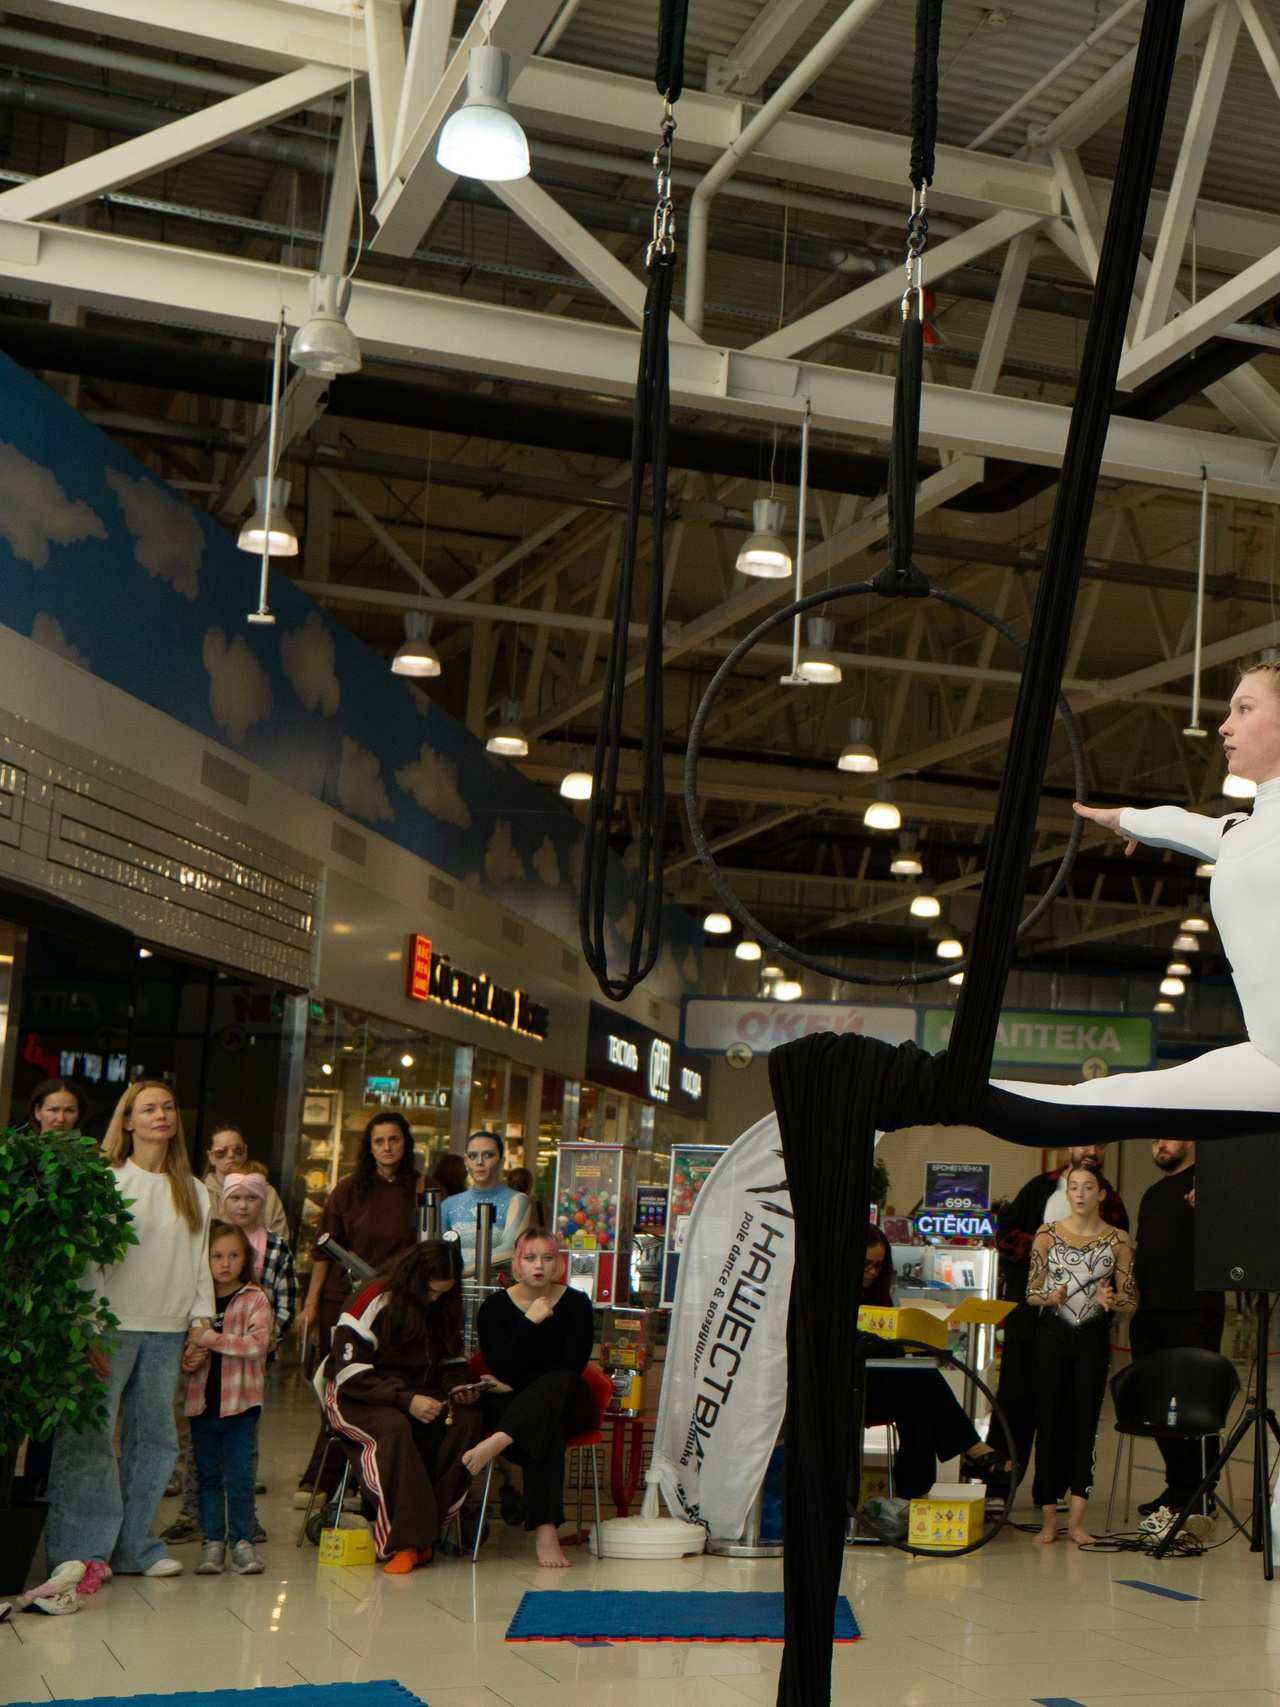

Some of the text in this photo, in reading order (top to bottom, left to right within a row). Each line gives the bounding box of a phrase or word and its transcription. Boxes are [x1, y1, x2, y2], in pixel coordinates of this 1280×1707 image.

[945, 1197, 972, 1208] 699
[736, 1211, 754, 1242] pole
[918, 1214, 993, 1234] СТЁКЛА
[719, 1244, 742, 1286] dance
[713, 1287, 725, 1299] &
[342, 1342, 354, 1361] 3
